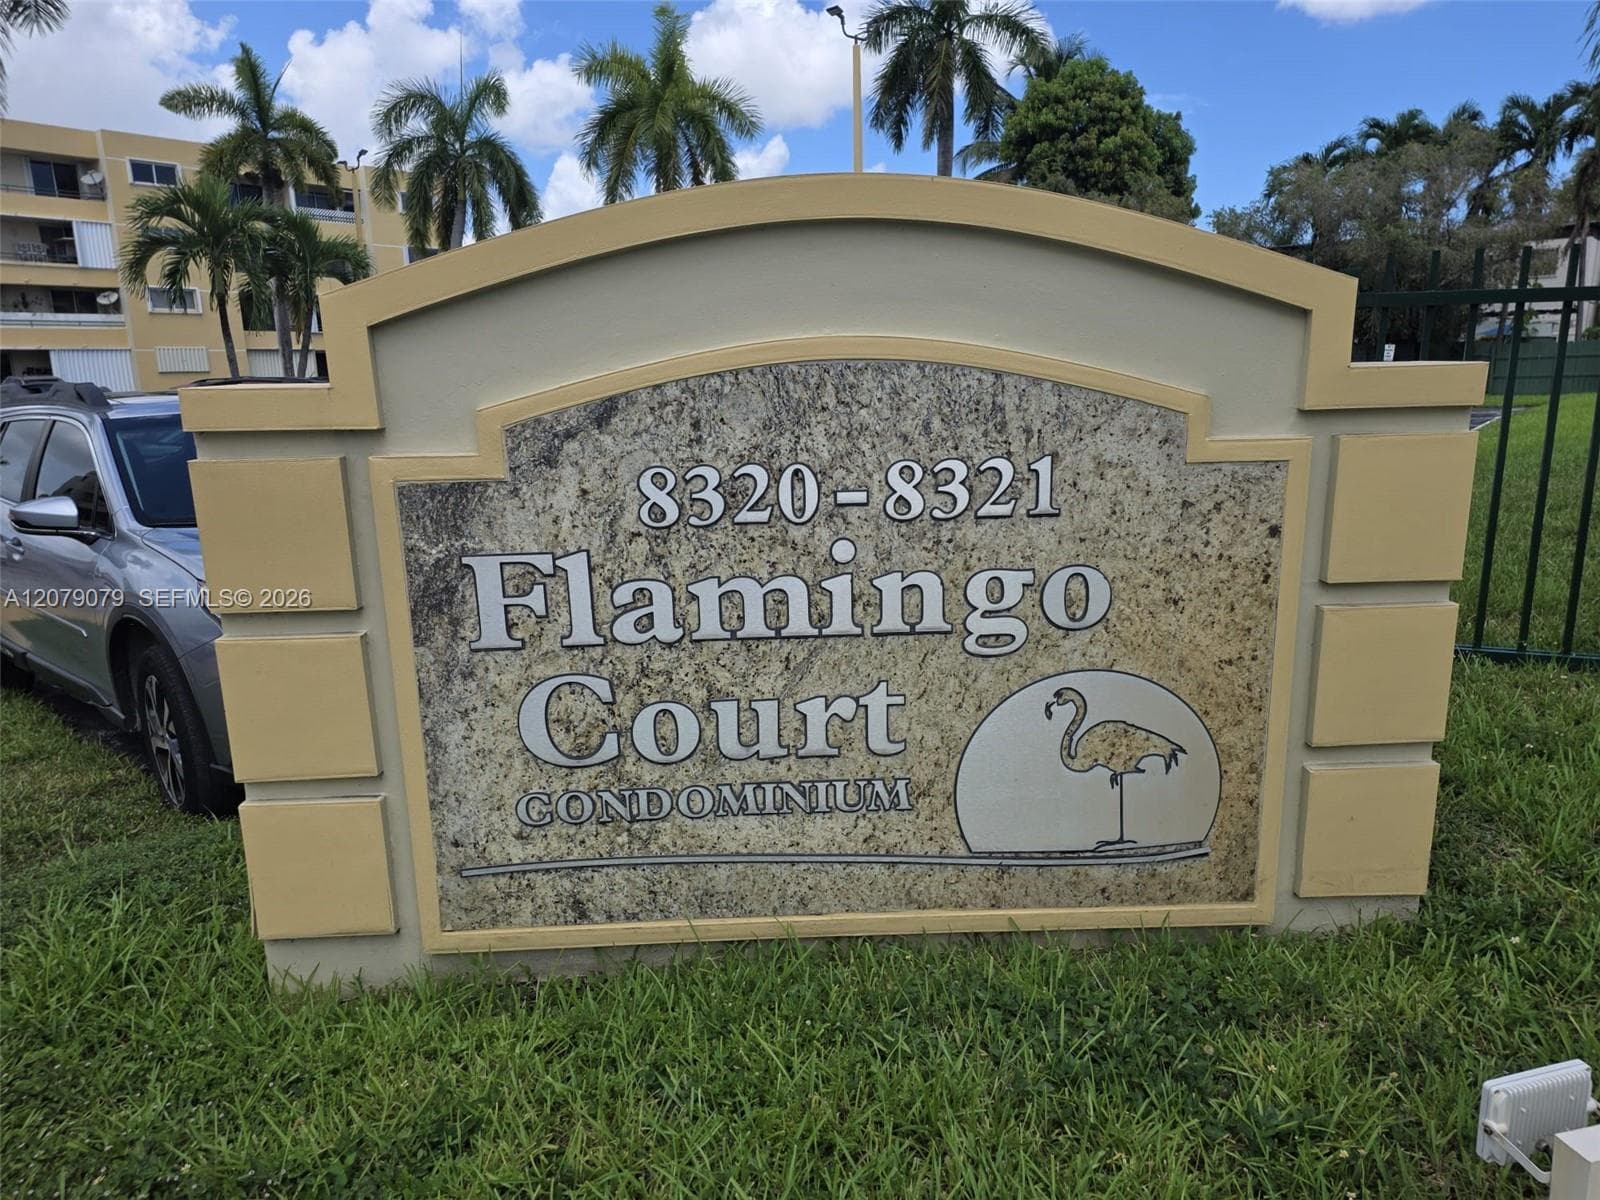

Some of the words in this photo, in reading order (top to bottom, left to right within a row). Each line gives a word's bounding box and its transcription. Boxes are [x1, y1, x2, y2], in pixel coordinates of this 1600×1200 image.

[460, 537, 1113, 657] Flamingo
[517, 672, 907, 768] Court
[515, 776, 913, 828] CONDOMINIUM
